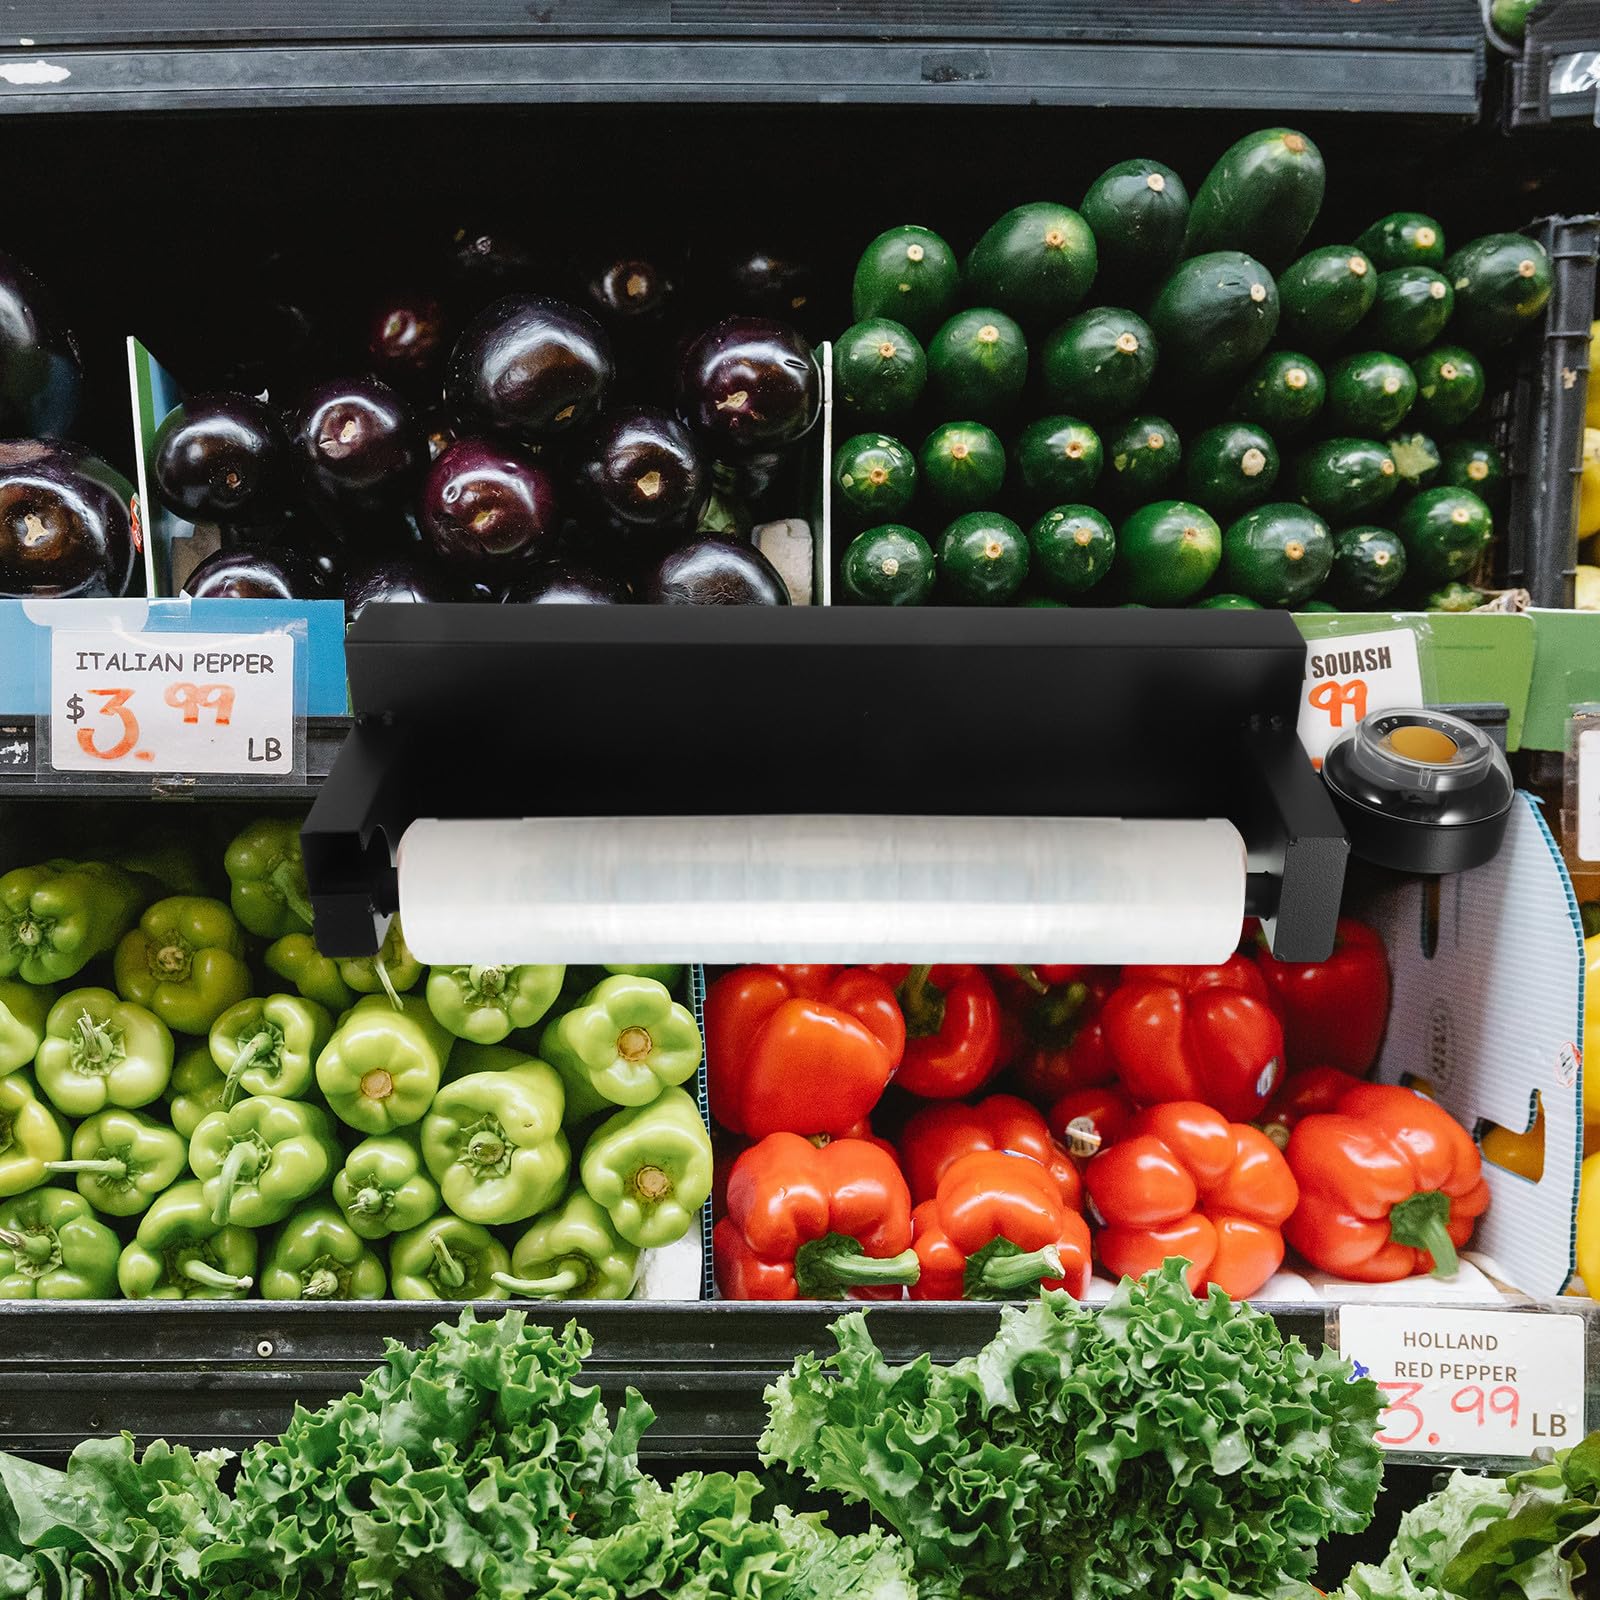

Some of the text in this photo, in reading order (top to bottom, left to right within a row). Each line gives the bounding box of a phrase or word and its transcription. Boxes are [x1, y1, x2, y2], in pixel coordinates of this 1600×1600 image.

[75, 651, 275, 674] ITALIAN PEPPER
[1310, 646, 1392, 678] SQUASH
[1308, 679, 1368, 727] 99
[247, 737, 283, 762] LB
[1403, 1331, 1499, 1351] HOLLAND
[1394, 1361, 1517, 1382] RED PEPPER
[1532, 1412, 1568, 1437] LB
